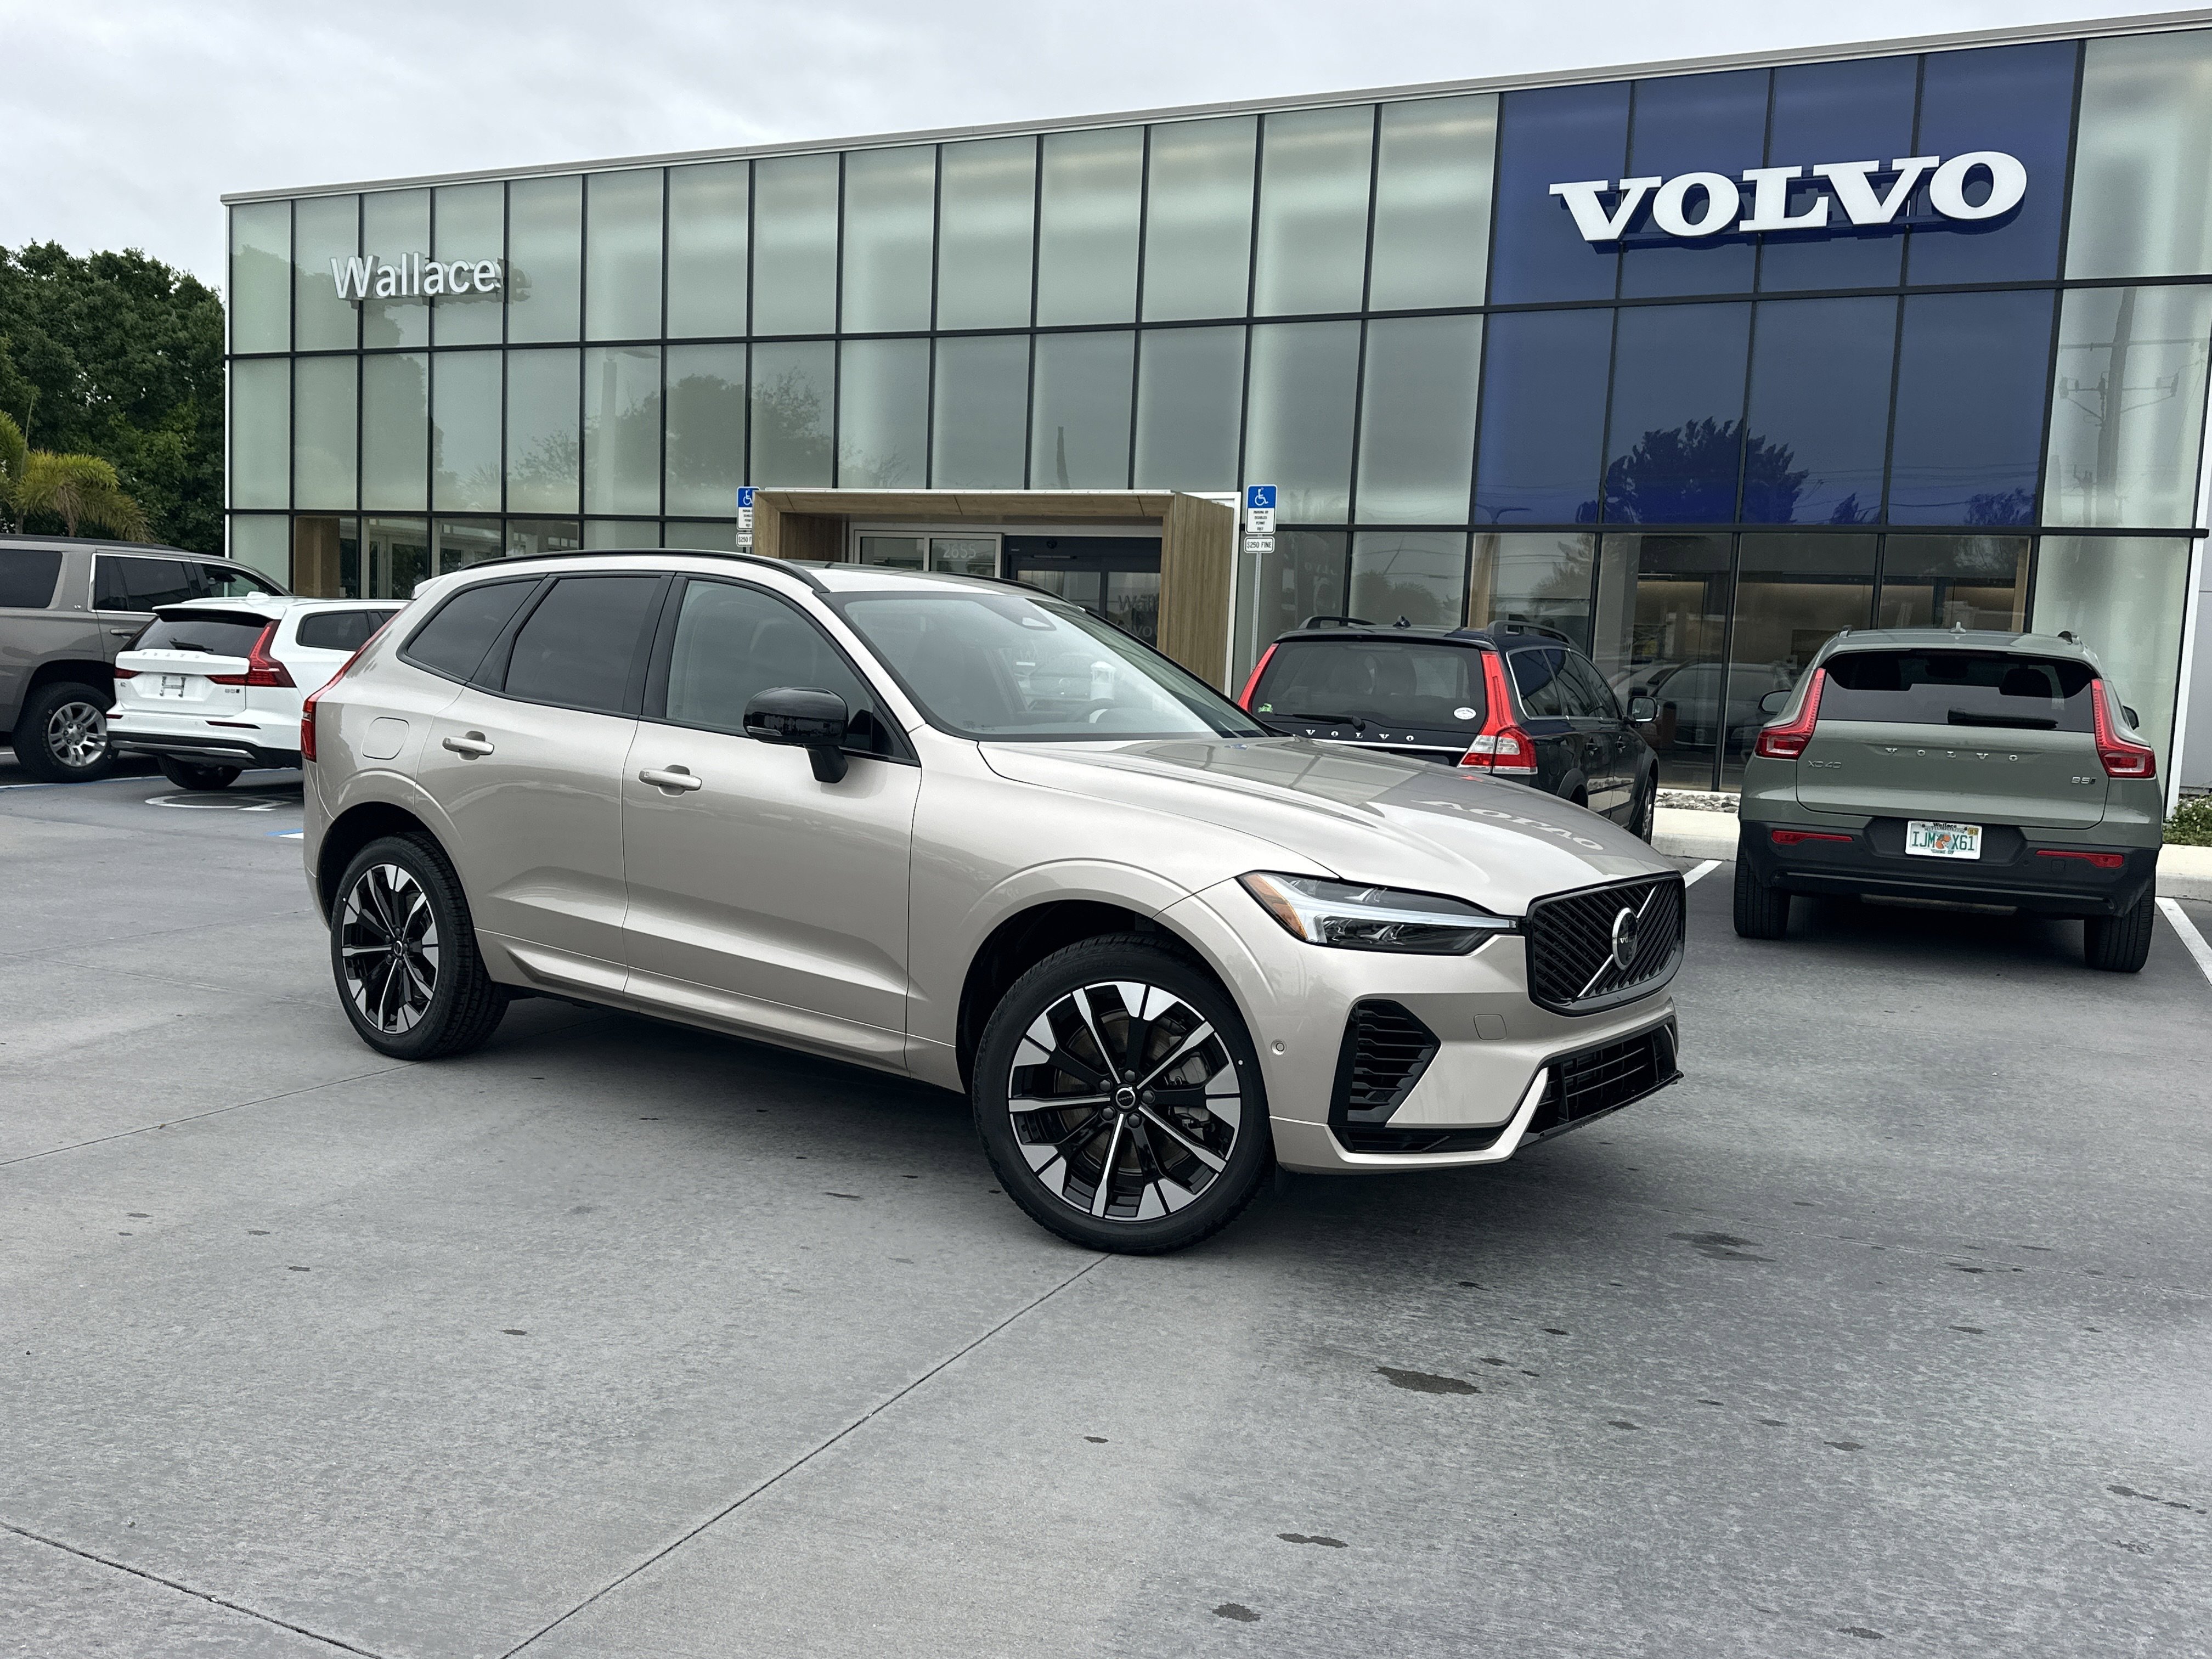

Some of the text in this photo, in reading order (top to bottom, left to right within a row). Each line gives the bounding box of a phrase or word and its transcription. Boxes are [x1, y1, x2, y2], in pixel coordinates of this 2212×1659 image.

[1548, 151, 2027, 241] VOLVO
[330, 252, 499, 299] Wallace
[943, 544, 977, 558] 2655
[1306, 729, 1414, 741] VOLVO
[1885, 748, 2018, 761] VOLVO
[1912, 831, 1974, 851] IJM X61
